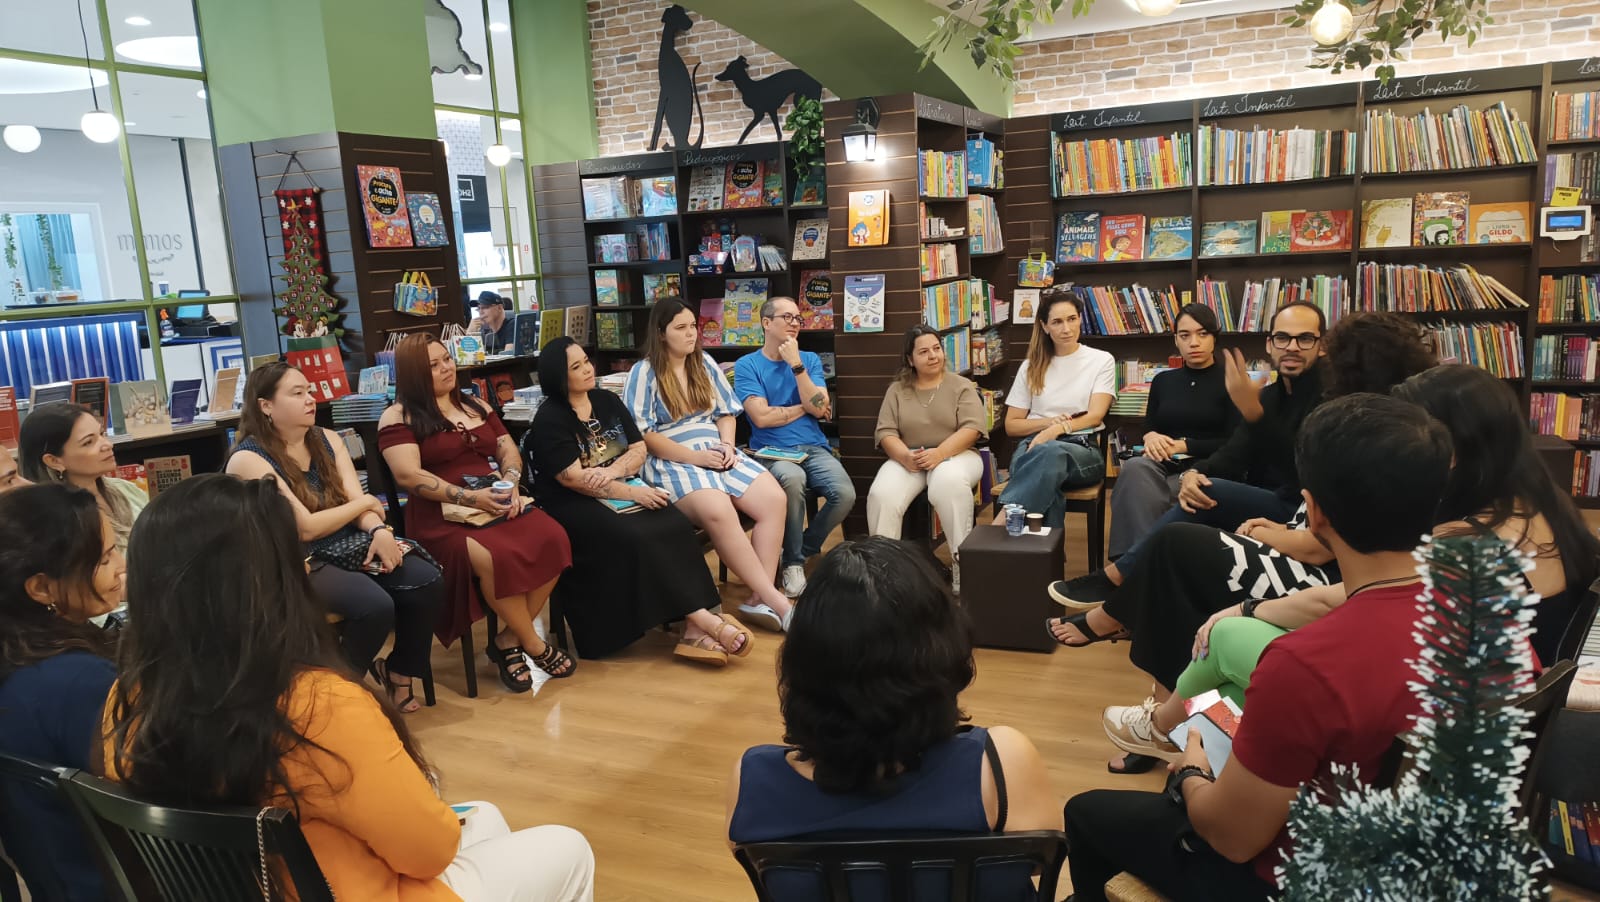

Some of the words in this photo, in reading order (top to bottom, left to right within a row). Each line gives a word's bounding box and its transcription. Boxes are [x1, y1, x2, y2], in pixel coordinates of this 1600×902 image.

[1411, 76, 1480, 97] Infantil
[1235, 94, 1296, 113] Infantil
[1094, 110, 1145, 127] Infantil
[370, 194, 397, 206] GIGANTE
[1064, 224, 1095, 233] ANIMAIS
[1153, 217, 1192, 227] ATLAS
[117, 233, 183, 251] mmos
